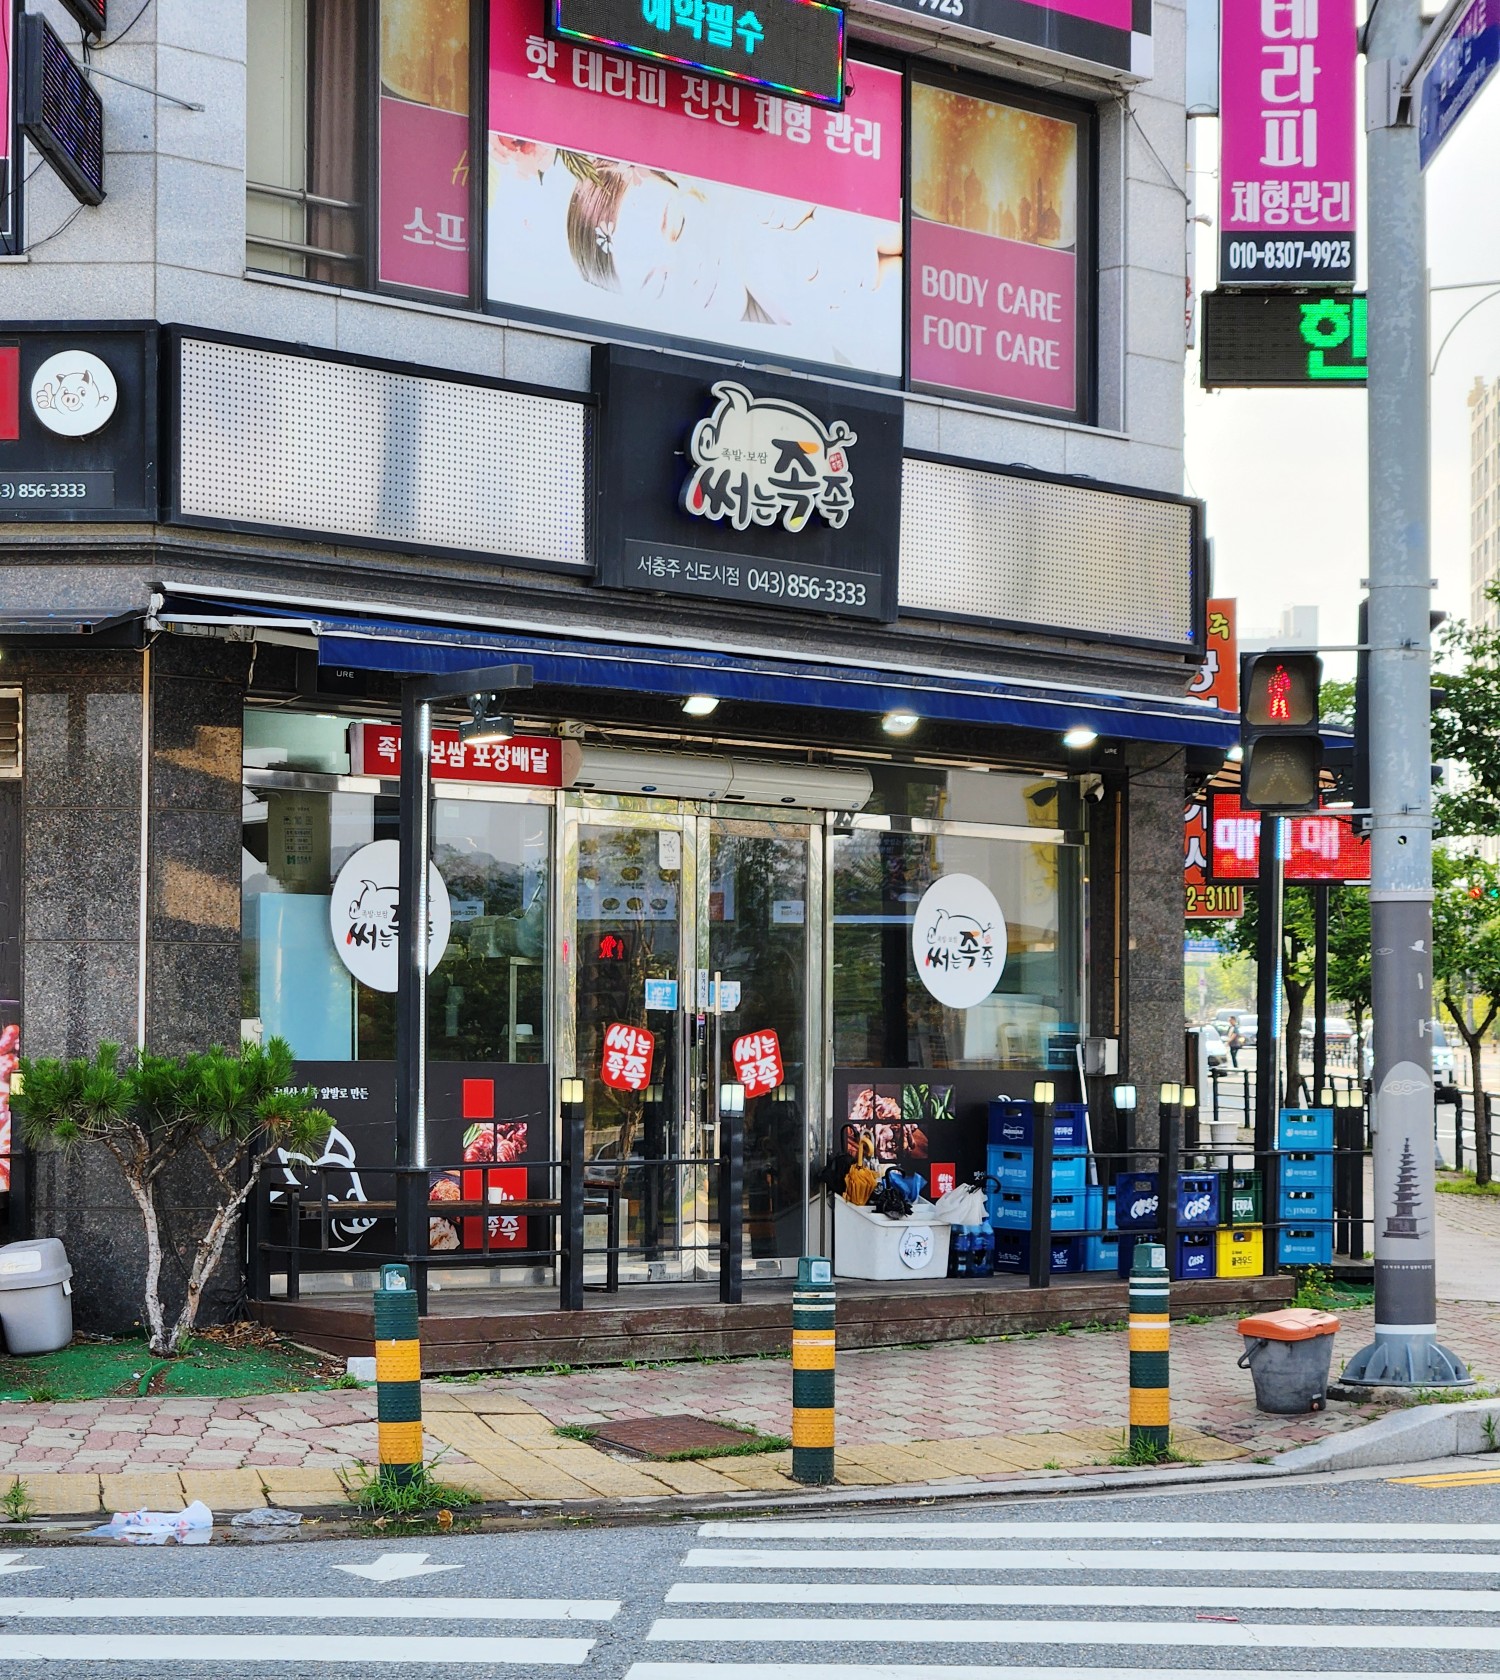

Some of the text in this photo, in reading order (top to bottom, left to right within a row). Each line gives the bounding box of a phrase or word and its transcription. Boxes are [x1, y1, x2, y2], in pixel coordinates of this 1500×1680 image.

[525, 35, 882, 160] 핫 테라피 전신 체형 관리
[1230, 180, 1350, 225] 체형관리
[402, 206, 469, 252] 소프
[1229, 241, 1351, 269] 010-8307-9923
[922, 265, 1062, 323] BODY CARE
[923, 315, 1061, 370] FOOT CARE
[0, 482, 86, 499] 3) 856-3333
[637, 555, 867, 606] 서충주 신도시점 043) 856-3333
[377, 735, 550, 774] 족 보쌈 포장배달
[320, 1087, 349, 1099] 앞발로
[350, 1087, 369, 1099] 만든
[1184, 1194, 1211, 1220] Cass
[1188, 1254, 1205, 1267] Cass
